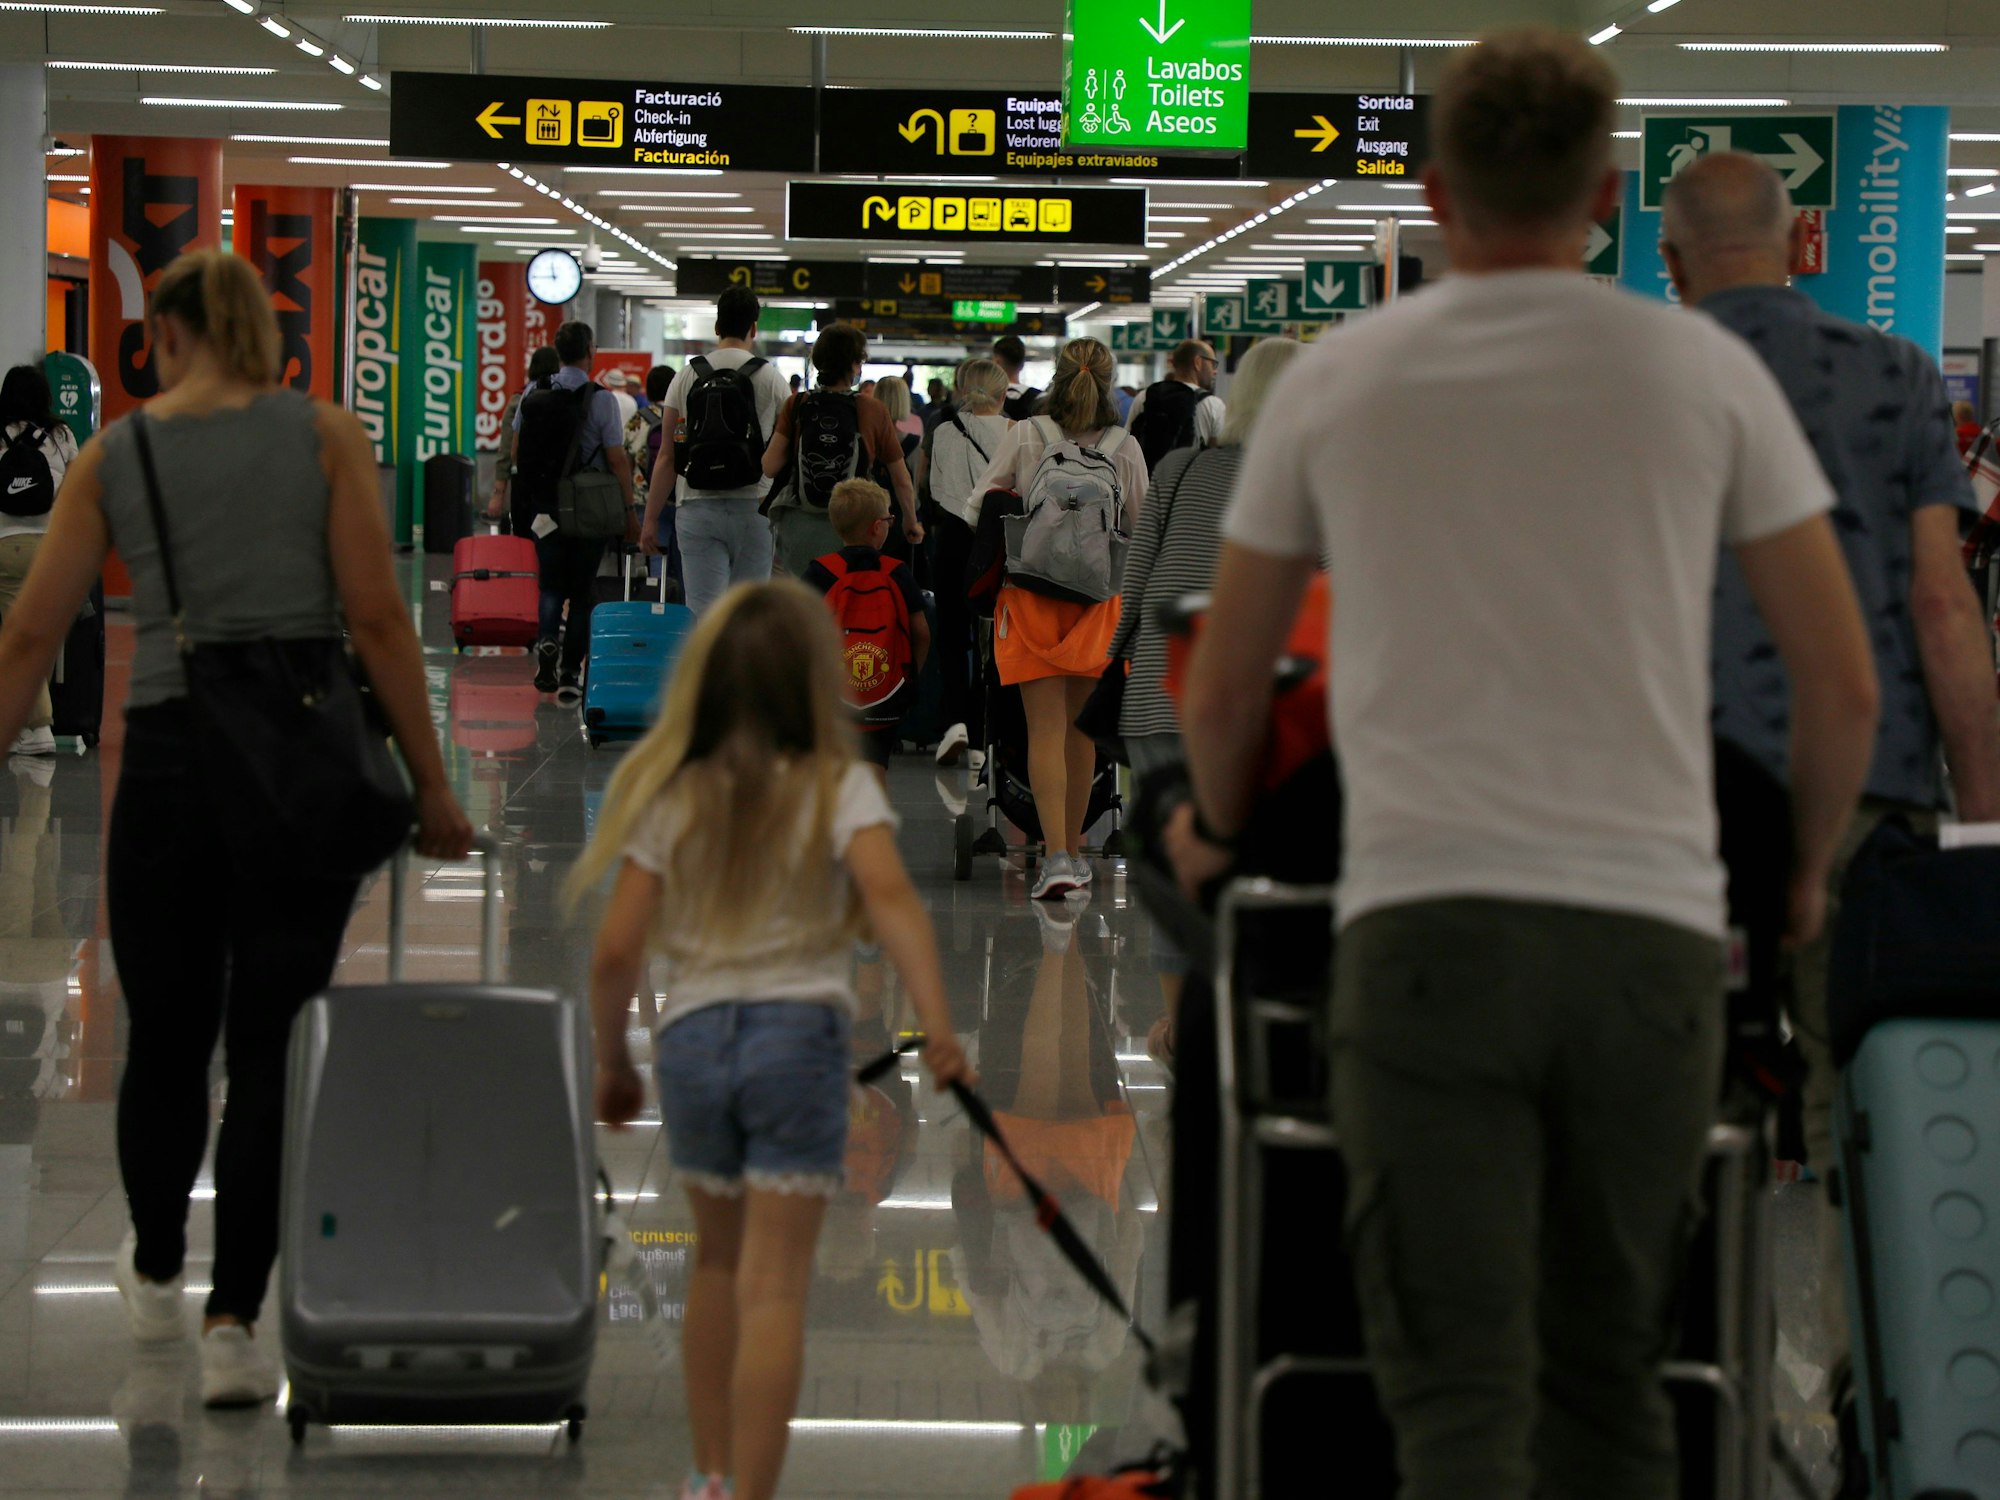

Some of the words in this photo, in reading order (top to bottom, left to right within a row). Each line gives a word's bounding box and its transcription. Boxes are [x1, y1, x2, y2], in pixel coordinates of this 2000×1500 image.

[1147, 56, 1243, 81] Lavabos
[635, 88, 723, 107] Facturació
[1147, 83, 1225, 108] Toilets
[1357, 95, 1415, 111] Sortida
[634, 108, 692, 126] Check-in
[1007, 116, 1036, 130] Lost
[1146, 110, 1218, 134] Aseos
[1357, 115, 1381, 132] Exit
[634, 128, 708, 148] Abfertigung
[1356, 137, 1409, 157] Ausgang
[634, 147, 731, 166] Facturación
[1006, 152, 1074, 169] Equipajes
[1077, 153, 1159, 168] extraviados
[1356, 158, 1406, 175] Salida
[910, 207, 921, 224] P
[943, 204, 958, 224] P
[117, 157, 199, 398] SXT
[792, 266, 812, 291] C
[355, 242, 400, 464] uropcar
[12, 476, 33, 487] NIKE
